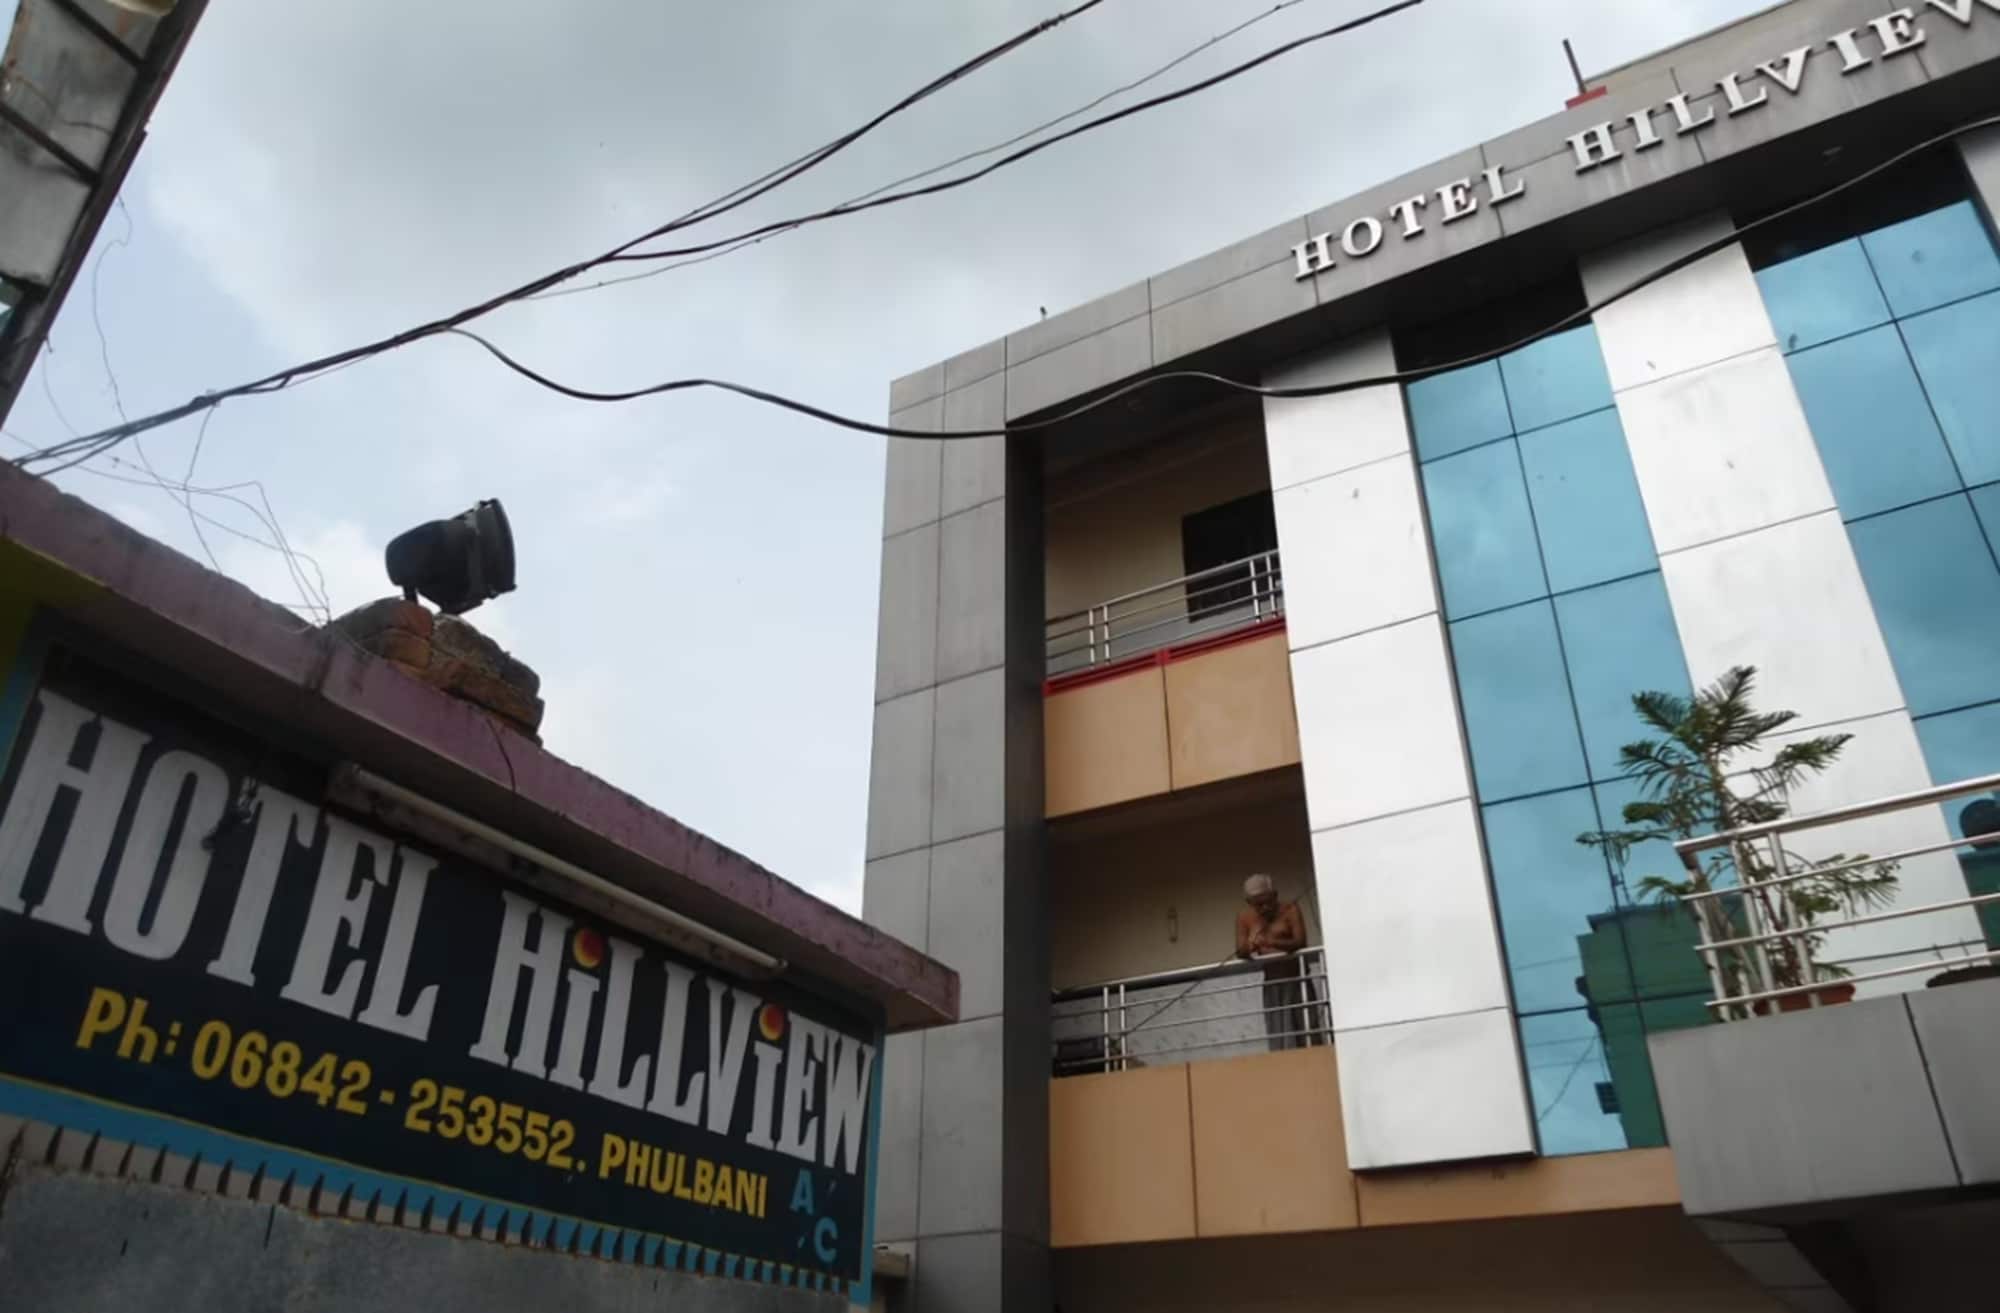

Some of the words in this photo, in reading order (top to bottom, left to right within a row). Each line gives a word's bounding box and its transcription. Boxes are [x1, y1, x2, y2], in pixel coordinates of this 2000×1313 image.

[1291, 166, 1524, 280] HOTEL
[0, 688, 440, 1042] HOTEL
[599, 1133, 768, 1219] PHULBANI
